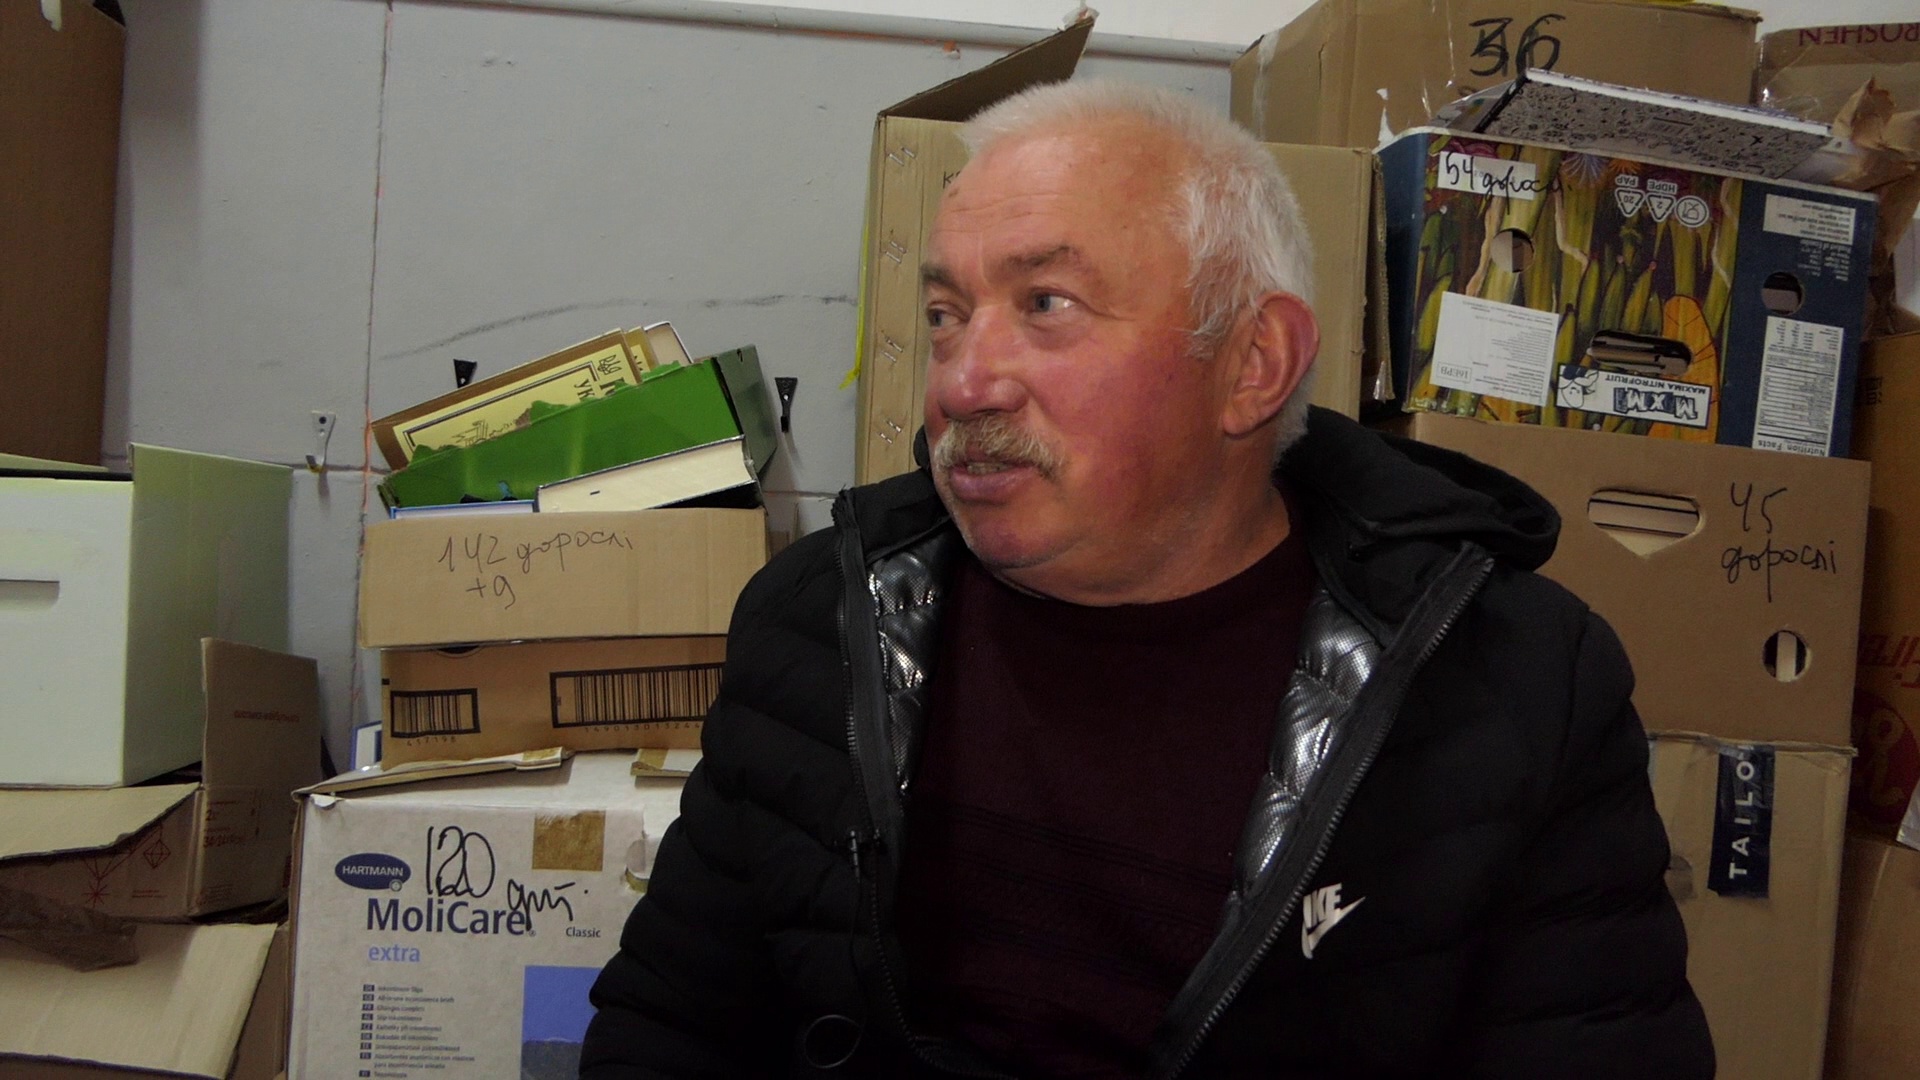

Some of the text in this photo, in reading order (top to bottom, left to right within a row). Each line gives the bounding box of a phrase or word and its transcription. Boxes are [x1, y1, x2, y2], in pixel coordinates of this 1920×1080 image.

[1446, 151, 1475, 190] 54
[1616, 175, 1637, 186] PAP
[1648, 181, 1676, 192] HDPE
[1604, 374, 1706, 395] MAXIMA NITROFRUIT
[1758, 440, 1826, 457] Nutrition Facts
[1730, 482, 1788, 533] 45
[437, 531, 508, 573] 142
[1728, 745, 1755, 880] TAILO
[341, 865, 404, 877] HARTMANN
[425, 825, 496, 898] 120
[565, 926, 601, 938] Classic
[368, 943, 421, 963] extra
